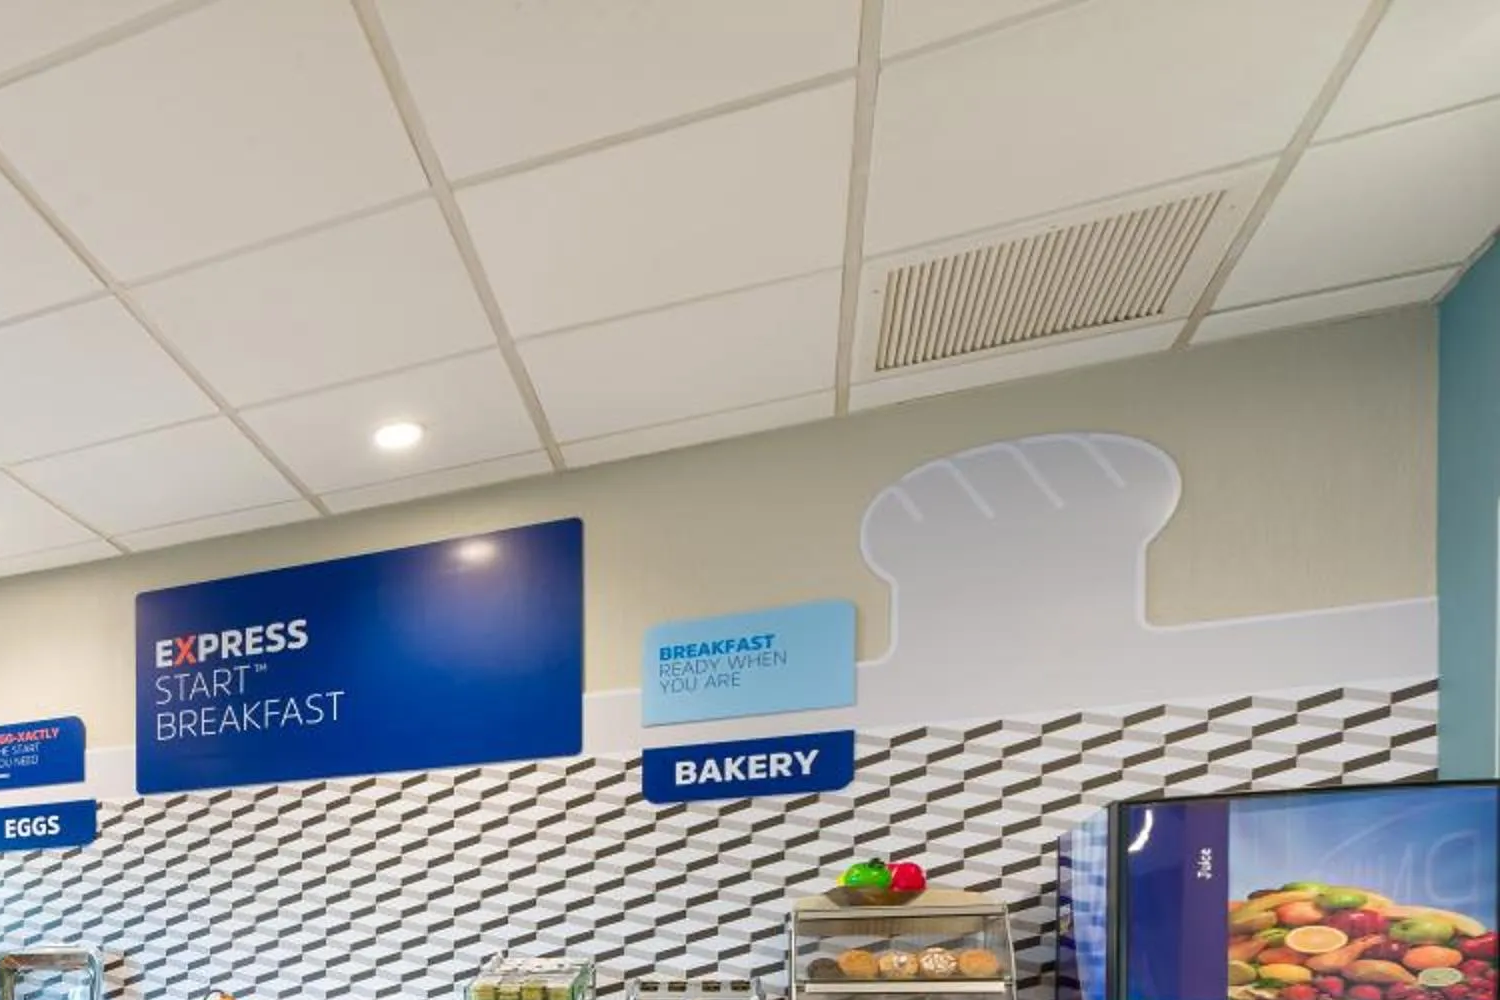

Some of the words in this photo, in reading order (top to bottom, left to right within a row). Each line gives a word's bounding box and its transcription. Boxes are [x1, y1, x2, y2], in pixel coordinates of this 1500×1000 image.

[155, 619, 308, 668] EXPRESS
[659, 633, 776, 661] BREAKFAST
[659, 657, 721, 677] READY
[728, 650, 787, 671] WHEN
[659, 676, 697, 695] YOU
[704, 671, 742, 690] ARE
[157, 691, 346, 742] BREAKFAST
[675, 749, 819, 786] BAKERY
[4, 815, 61, 839] EGGS
